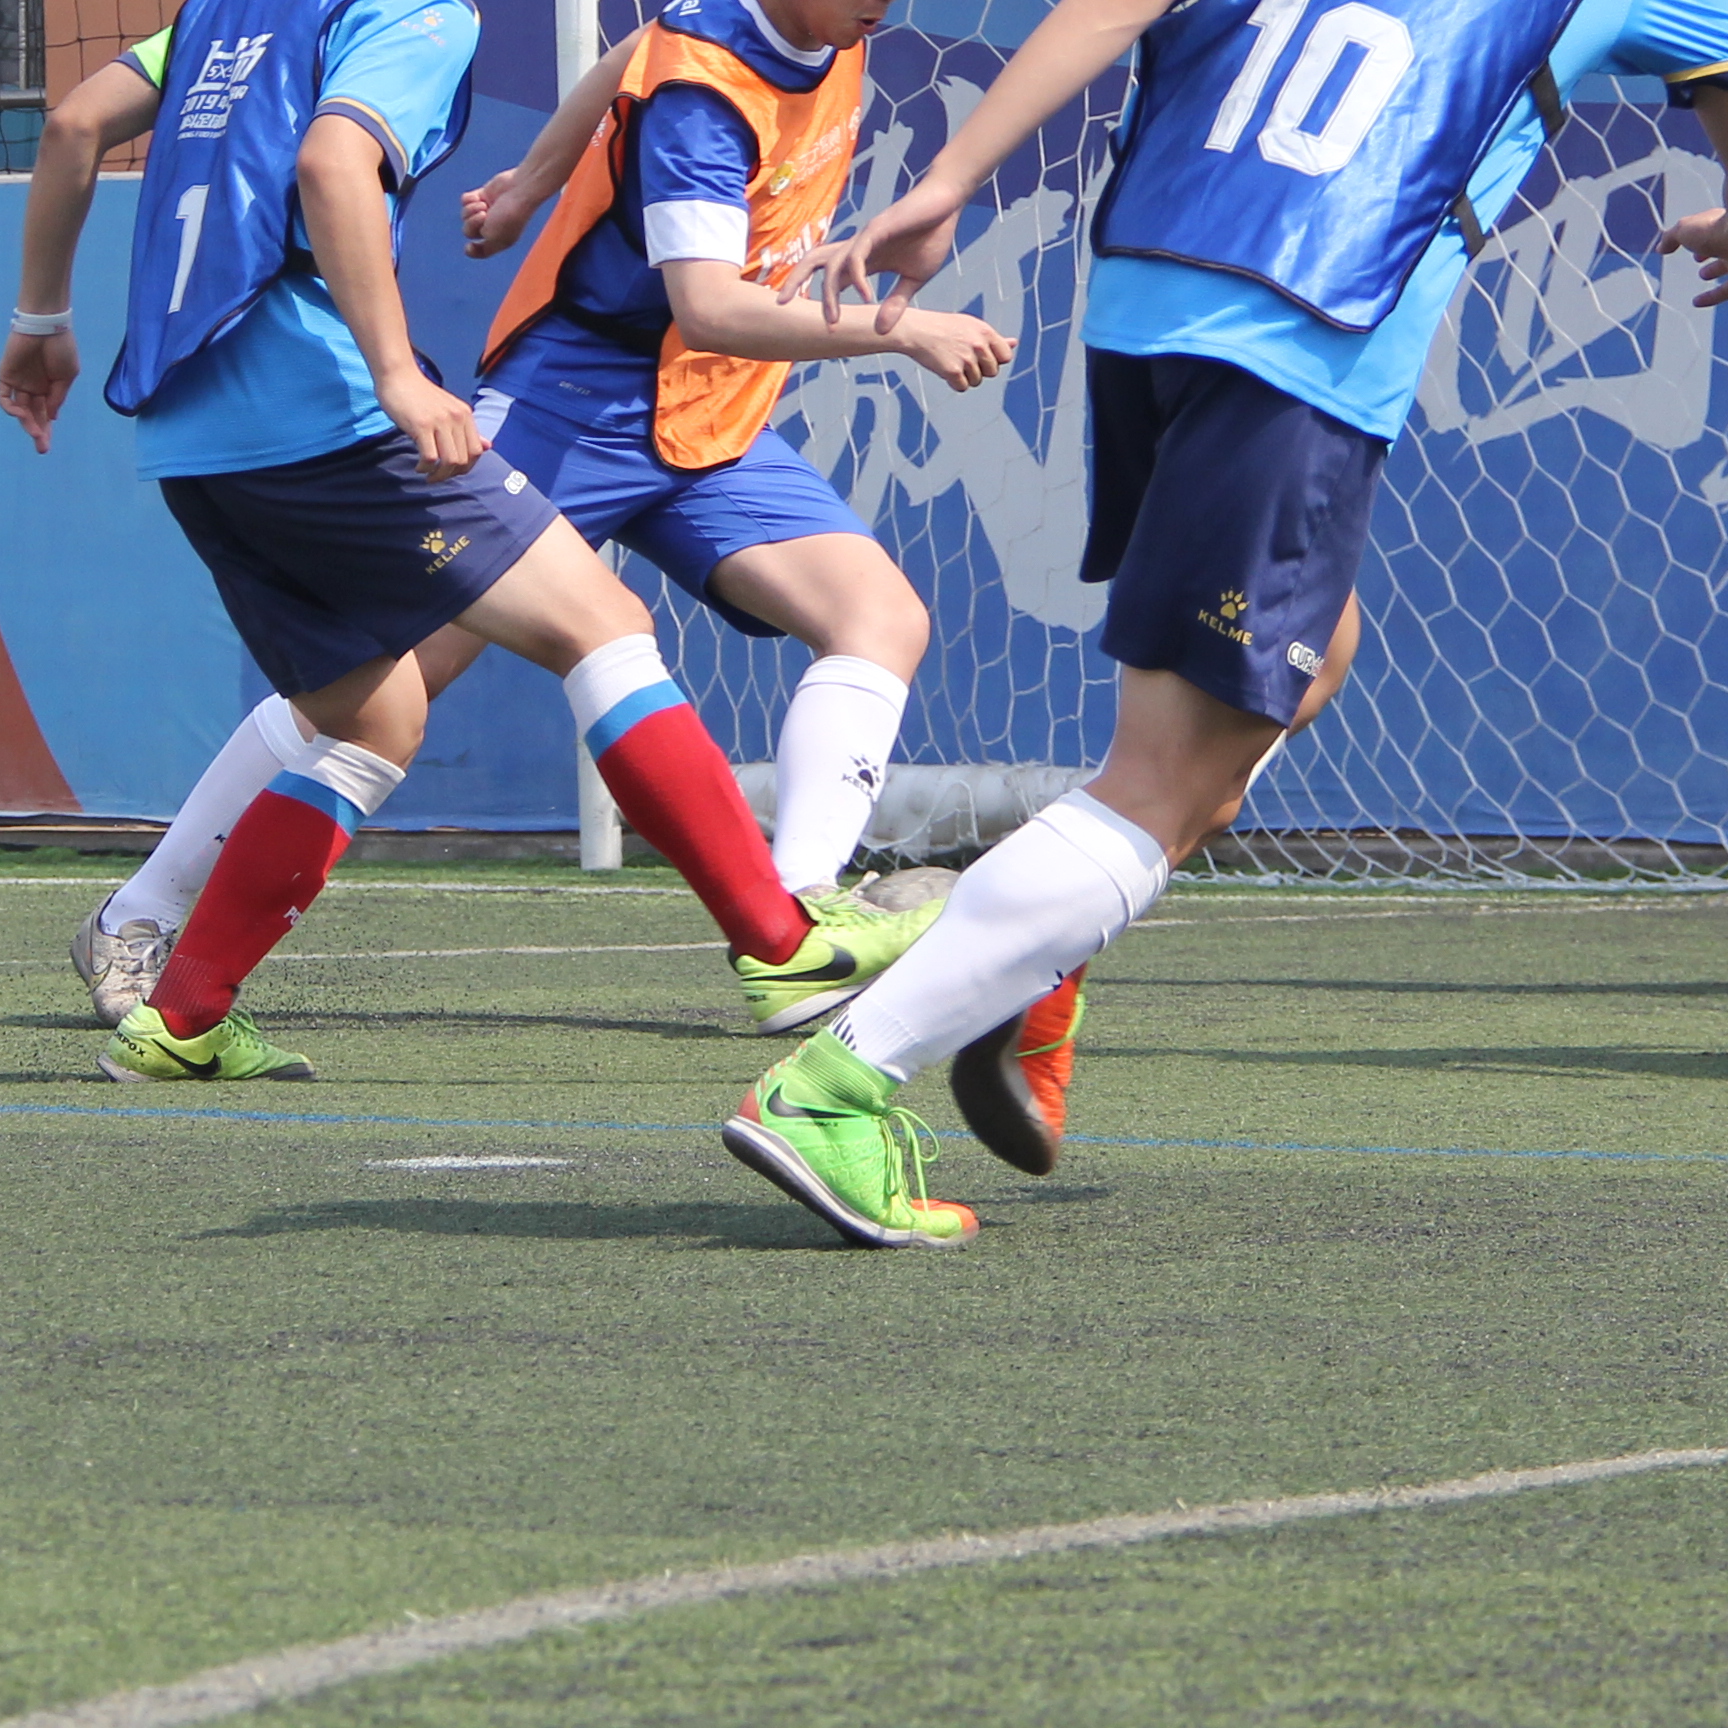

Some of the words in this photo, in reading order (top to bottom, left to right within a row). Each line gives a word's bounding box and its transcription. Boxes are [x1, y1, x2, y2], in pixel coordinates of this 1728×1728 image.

[167, 185, 208, 313] 1
[425, 535, 471, 575] KELME
[1197, 609, 1254, 646] KELME
